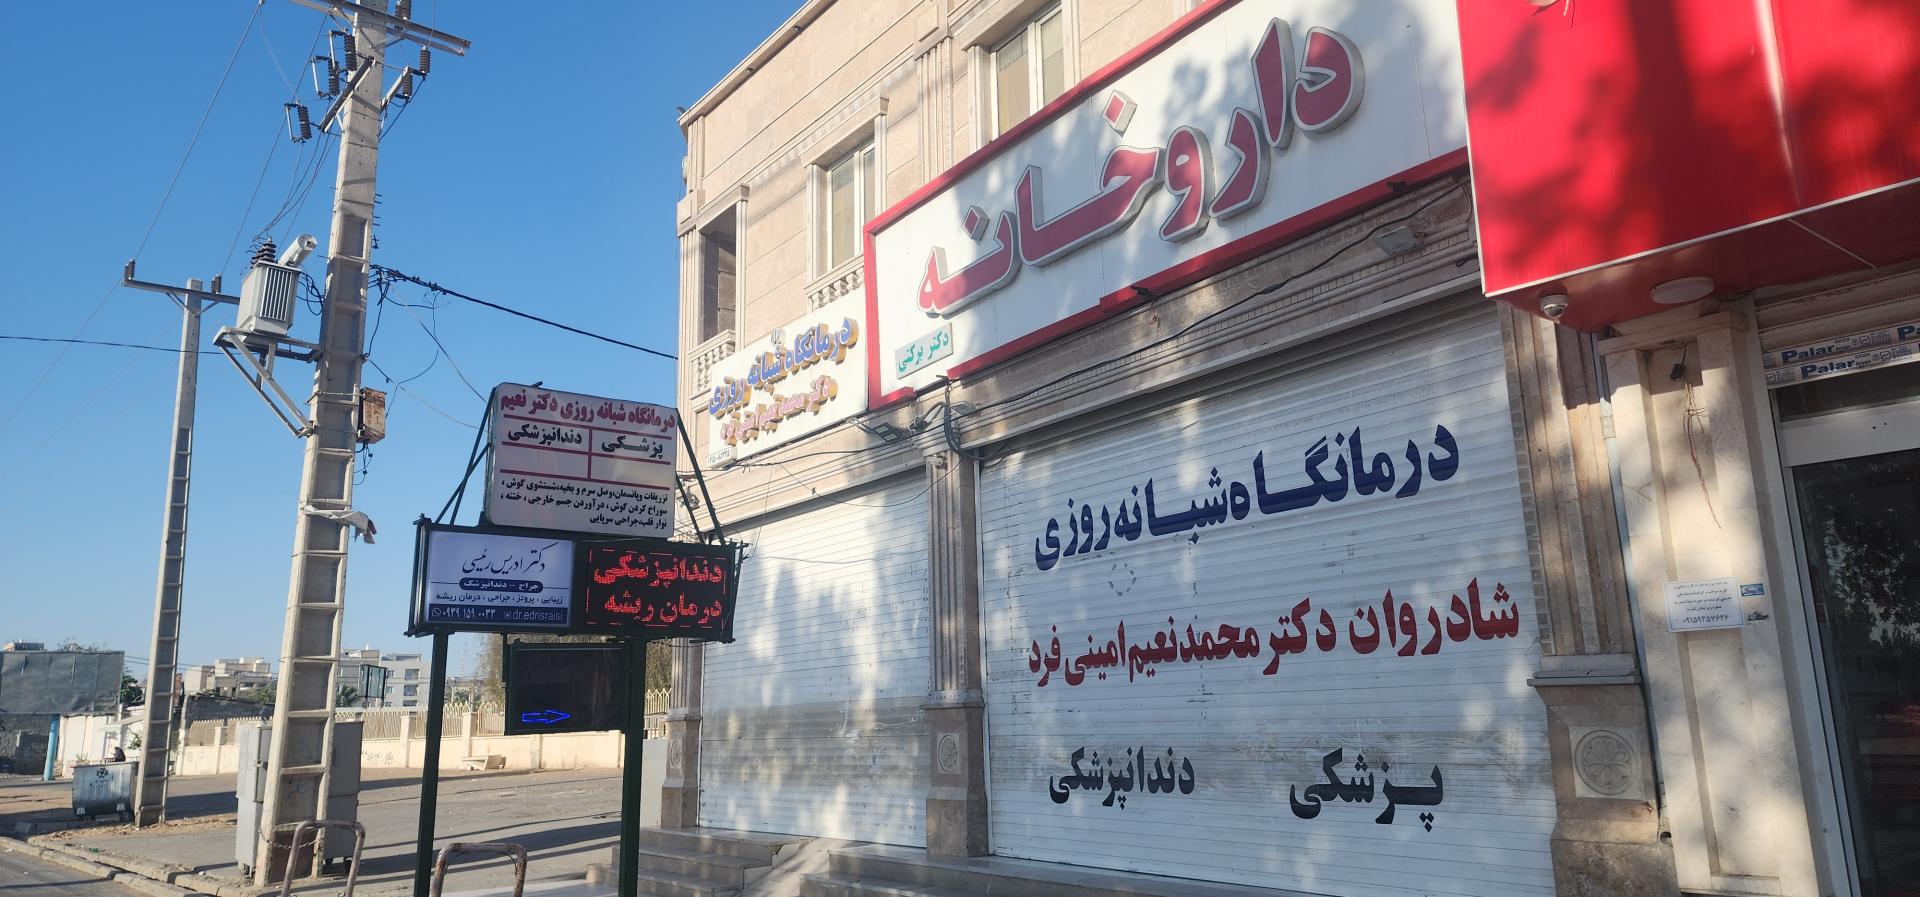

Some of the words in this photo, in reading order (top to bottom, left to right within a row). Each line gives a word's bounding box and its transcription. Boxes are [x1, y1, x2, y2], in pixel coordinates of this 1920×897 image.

[917, 17, 1364, 318] داروخانه
[784, 317, 856, 371] درمانگاه
[928, 331, 948, 360] دکتر
[1781, 344, 1835, 365] Palar
[748, 344, 785, 392] شبانه
[1800, 359, 1855, 380] Palar
[501, 389, 526, 410] نعیم
[529, 393, 557, 415] دکتر
[709, 376, 746, 416] روزی
[560, 400, 594, 423] روزی
[597, 402, 626, 426] شبانه
[628, 405, 675, 433] درمانگاه
[508, 424, 582, 446] دندانپزشکی
[602, 435, 663, 459] پزشکی
[1230, 424, 1459, 521] درمانگاه
[528, 494, 554, 505] خارجی
[629, 504, 646, 514] کردن
[644, 492, 668, 503] تزریقات
[1114, 467, 1228, 544] شبانه
[648, 505, 667, 516] سوراخ
[655, 519, 667, 529] نوار
[1035, 498, 1111, 571] روزی
[491, 554, 523, 575] ادریس
[523, 542, 559, 573] دکتر
[593, 554, 723, 588] دندانپزشکی
[436, 592, 456, 601] ریشه
[463, 580, 507, 589] دندانپزشک
[519, 583, 539, 591] جراح
[459, 593, 481, 602] درمان
[604, 590, 653, 622] ریشه
[660, 592, 722, 624] درمان
[1263, 597, 1338, 676] دکتر
[1049, 746, 1195, 810] دندانپزشکی
[1290, 748, 1444, 832] پزشکی
